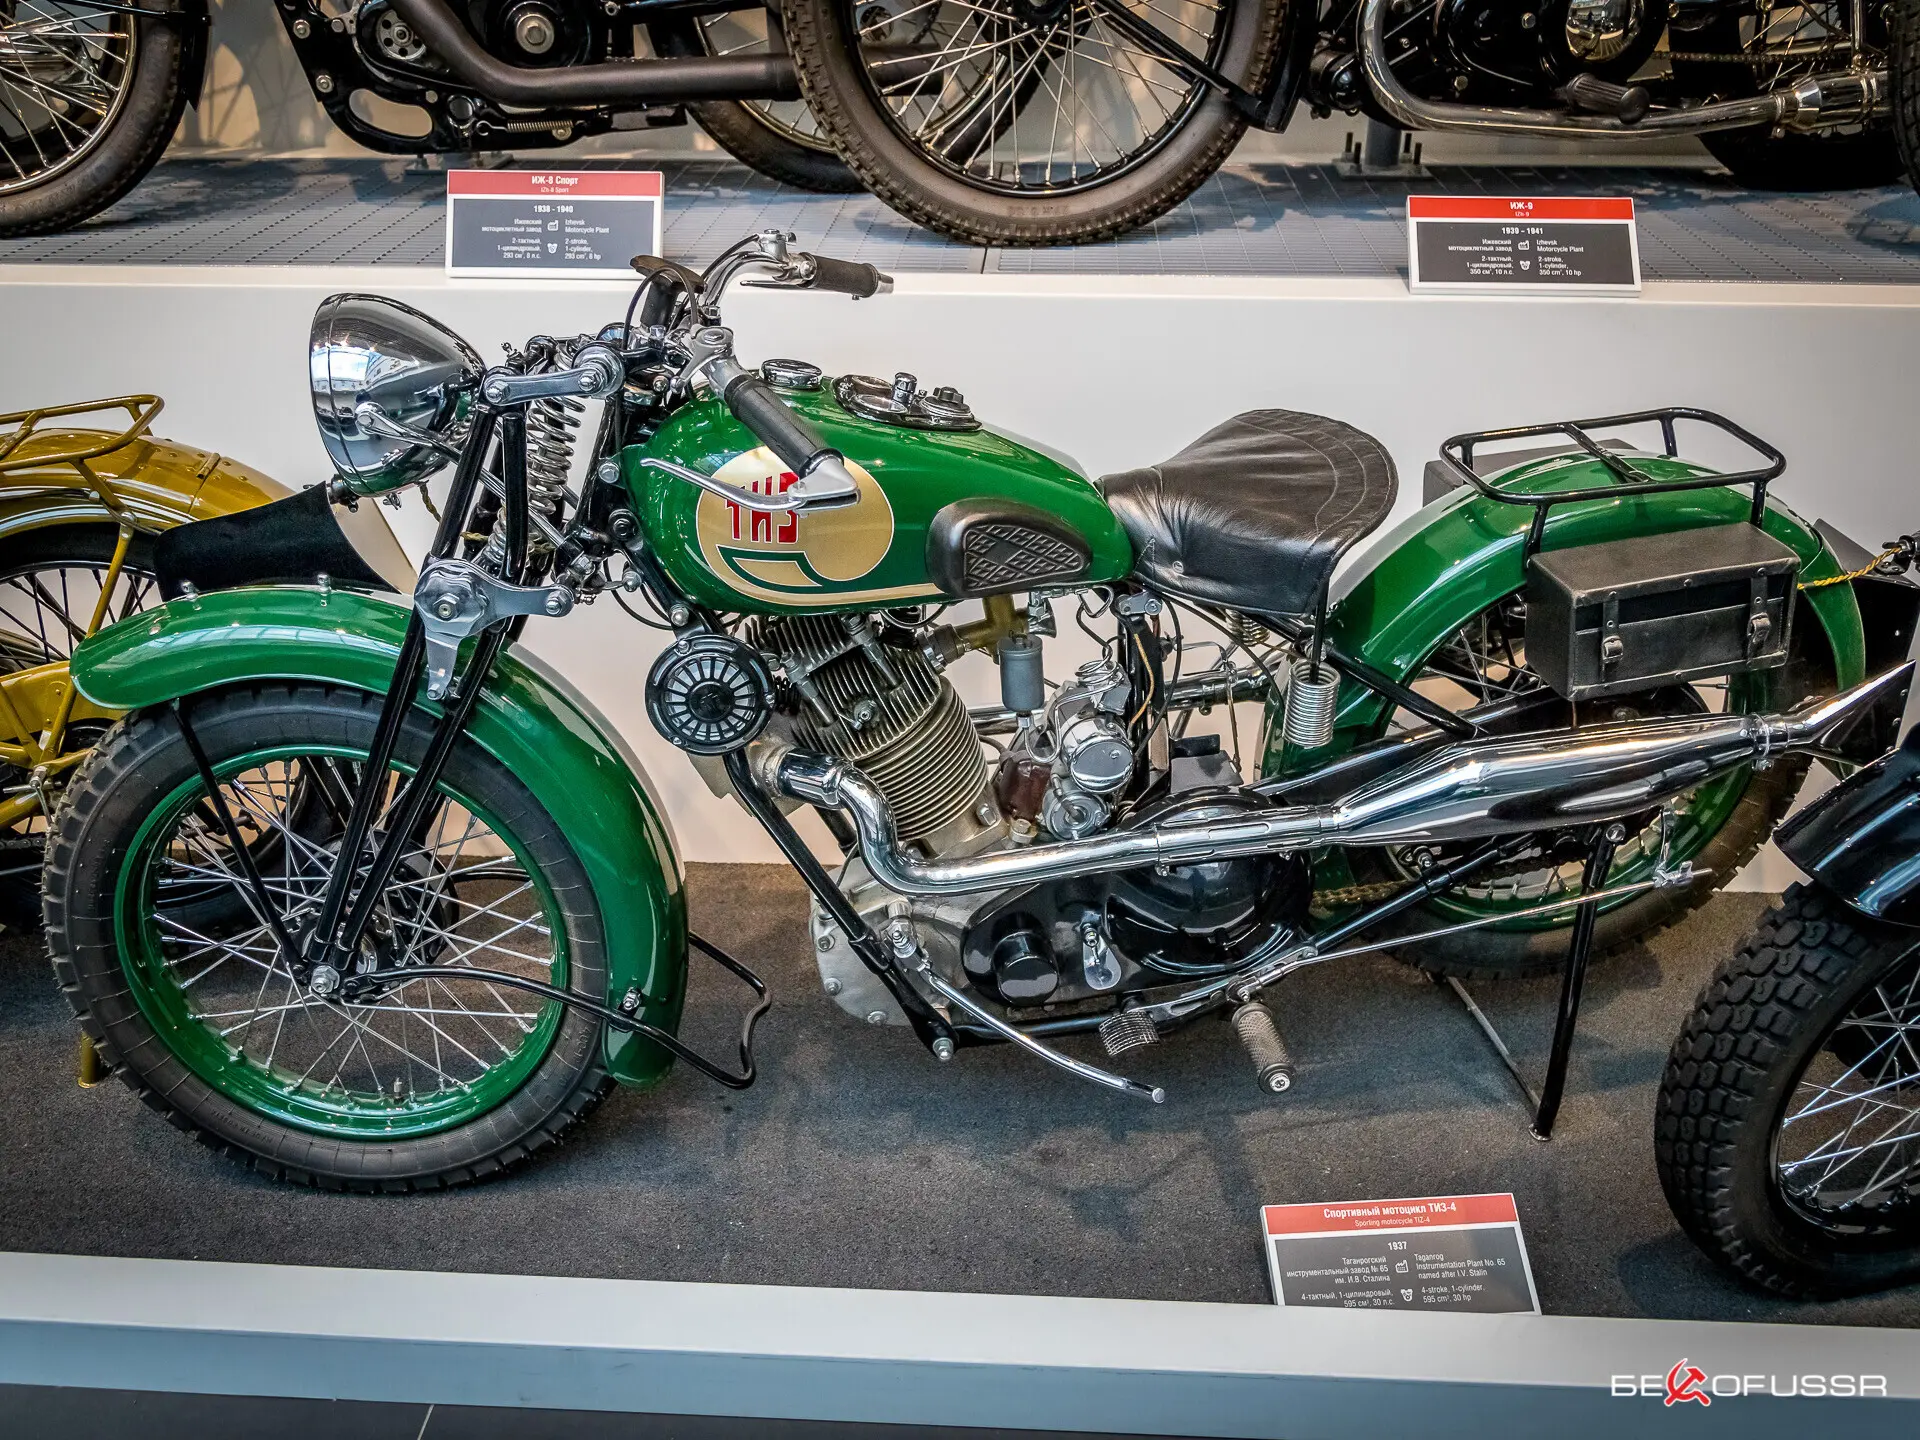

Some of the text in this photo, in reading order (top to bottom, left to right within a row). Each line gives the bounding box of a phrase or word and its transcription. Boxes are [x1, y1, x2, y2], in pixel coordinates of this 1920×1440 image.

[532, 176, 578, 186] ИЖ-8 Спорт
[1510, 202, 1533, 210] ИЖ-9
[1324, 1202, 1456, 1219] Спортивный мотоцикл ТИЗ-4
[1354, 1218, 1380, 1227] Sporting
[1382, 1217, 1413, 1226] motorcycle
[1388, 1241, 1407, 1250] 1937
[1342, 1256, 1386, 1266] Таганрогский
[1414, 1254, 1444, 1262] Taganrog
[1416, 1258, 1506, 1270] Instrumentation Plant No. 65
[1286, 1267, 1350, 1278] инструментальный
[1350, 1266, 1370, 1274] завод
[1418, 1272, 1440, 1280] named
[1442, 1270, 1456, 1278] after
[1470, 1268, 1488, 1276] Stalin
[1348, 1276, 1362, 1284] И.В.
[1362, 1274, 1390, 1282] Сталина
[1301, 1288, 1394, 1300] 4-тактный, 1-цилиндровый,
[1422, 1284, 1486, 1294] 4-stroke, 1-cylinder,
[1452, 1294, 1462, 1302] 30
[1463, 1293, 1472, 1302] hp
[1344, 1300, 1356, 1308] 595
